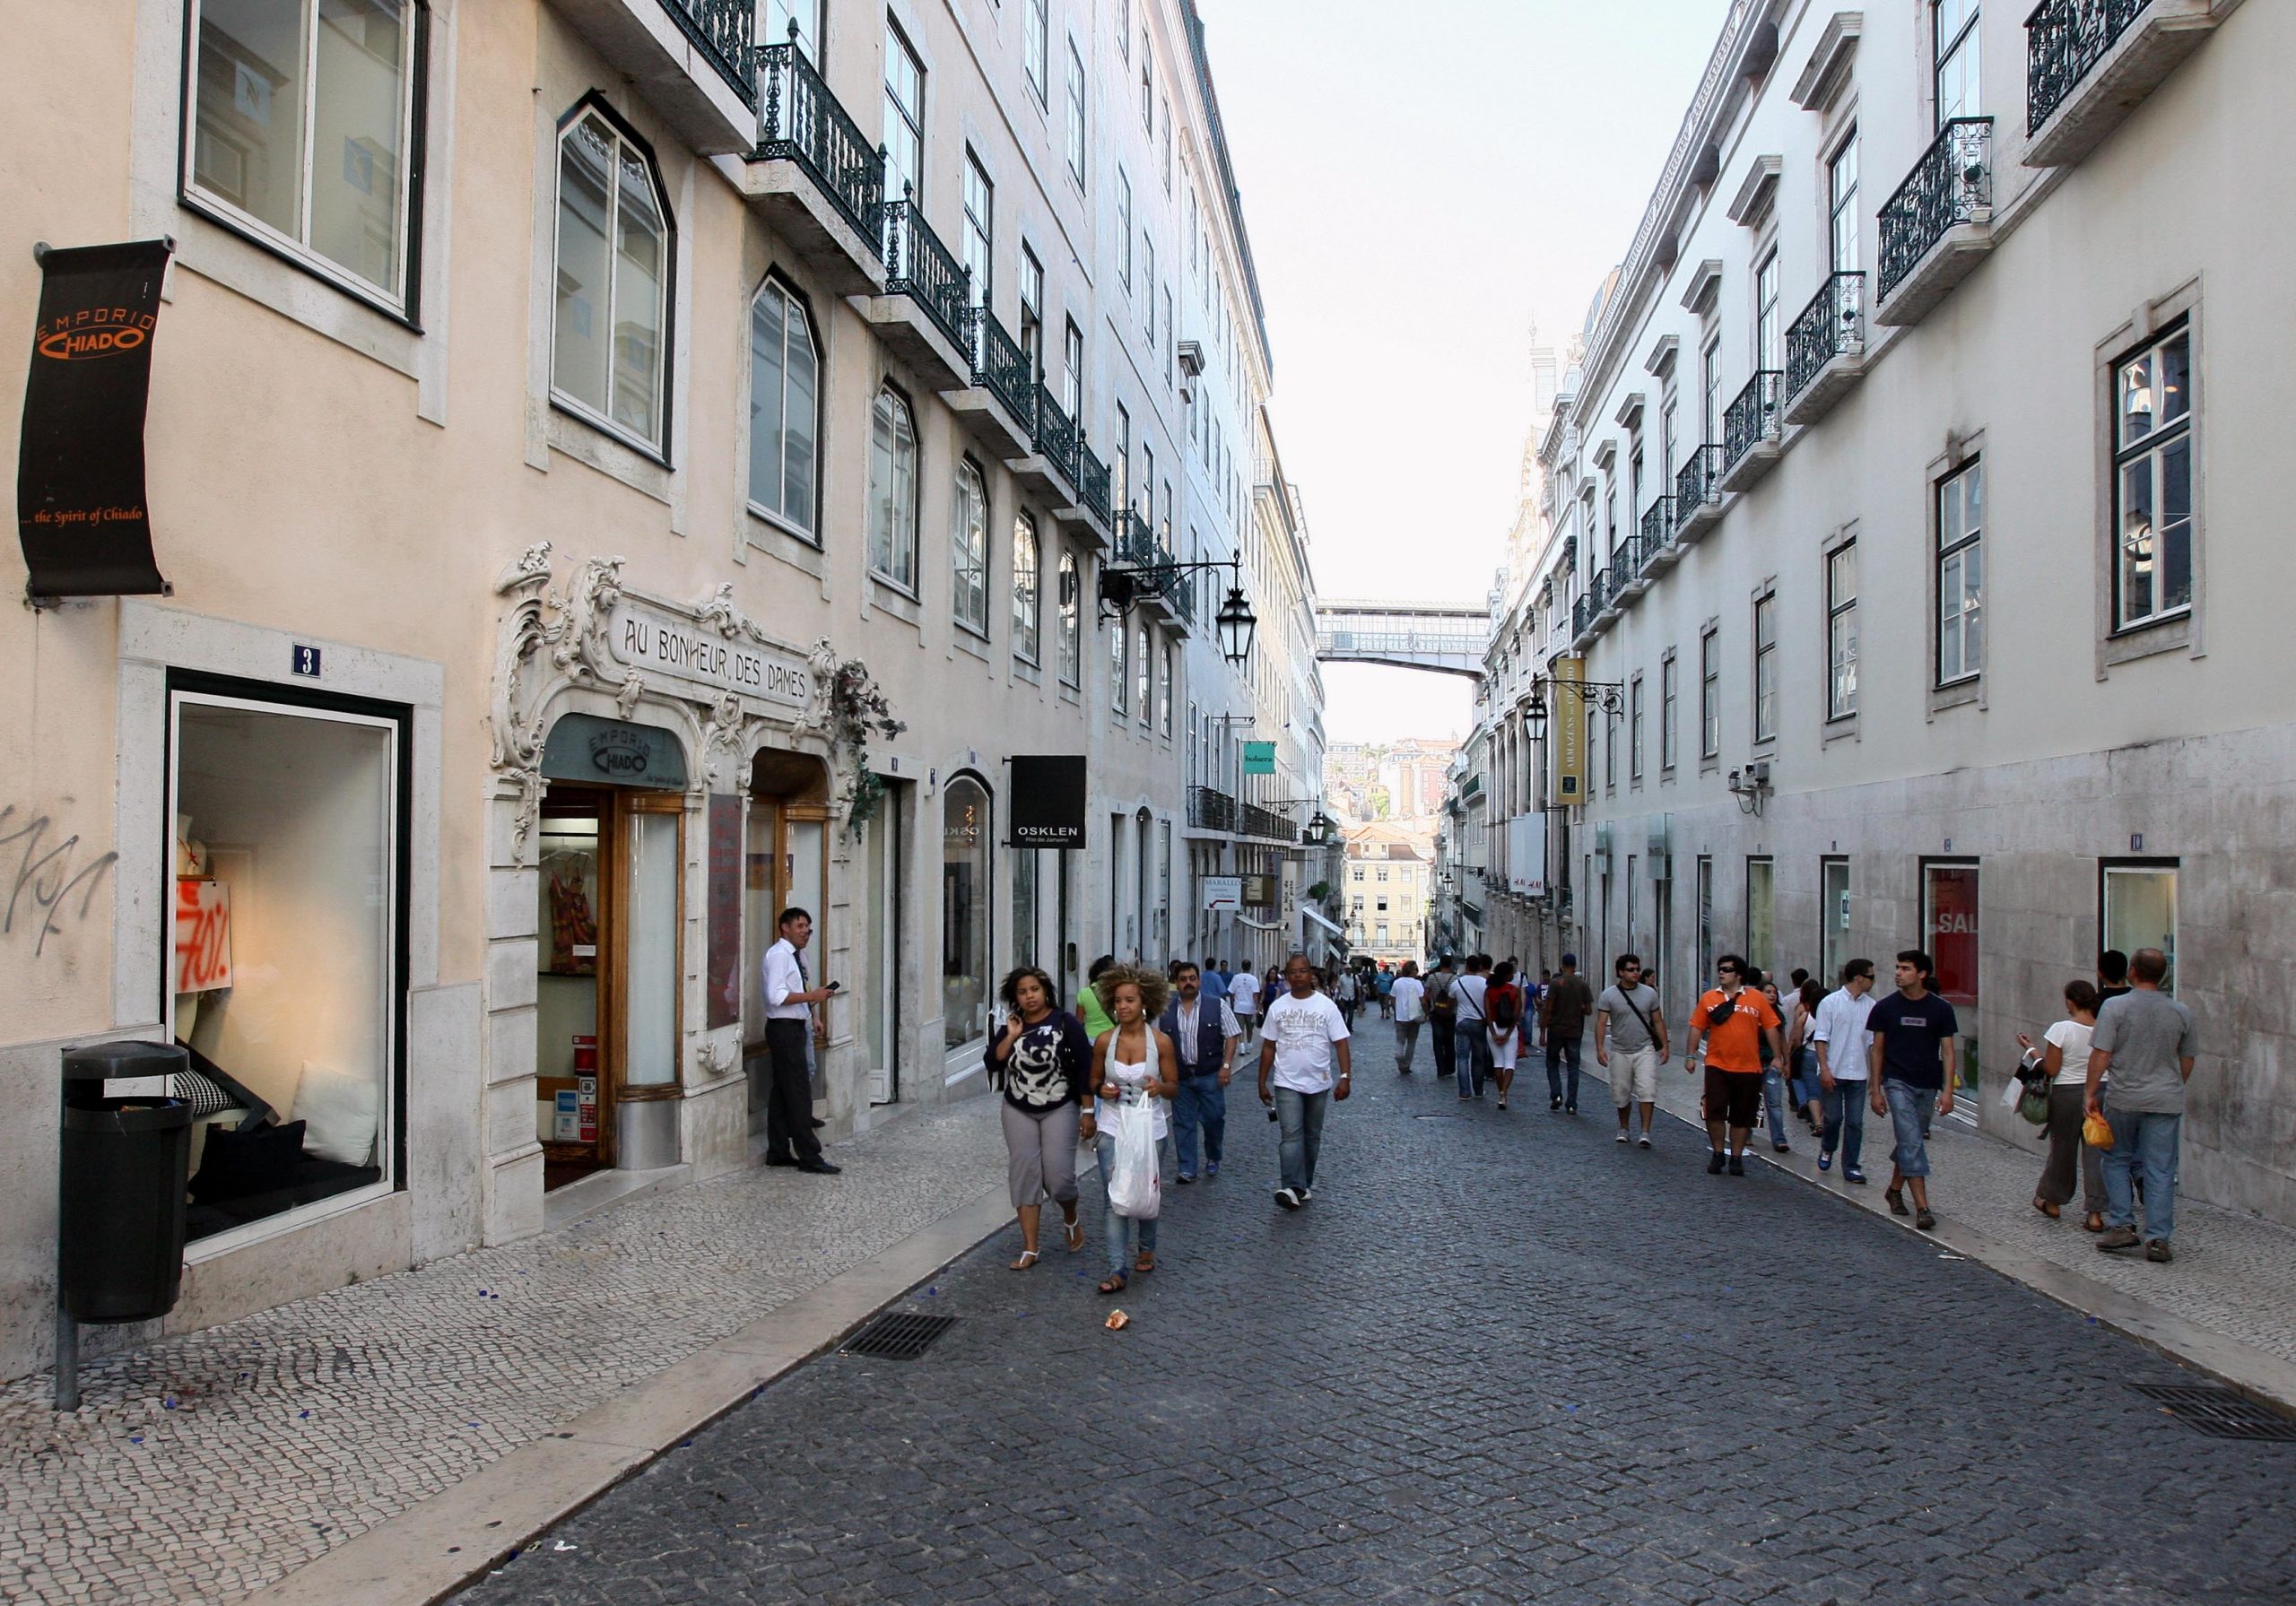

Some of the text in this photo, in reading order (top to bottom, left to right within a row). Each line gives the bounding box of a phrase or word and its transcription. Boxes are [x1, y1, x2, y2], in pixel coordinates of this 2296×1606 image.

[37, 308, 155, 341] EMPORIO
[39, 327, 144, 359] CHIADO
[35, 509, 52, 523] the
[55, 509, 86, 527] Spirit
[90, 507, 101, 526] of
[103, 506, 143, 520] Chiado
[302, 648, 313, 673] 3
[624, 619, 648, 654] AU
[736, 654, 761, 685] DES
[768, 664, 805, 699] DAMES
[593, 747, 647, 775] CHIADO
[1018, 827, 1078, 836] OSKLEN
[1939, 912, 1979, 933] SAL
